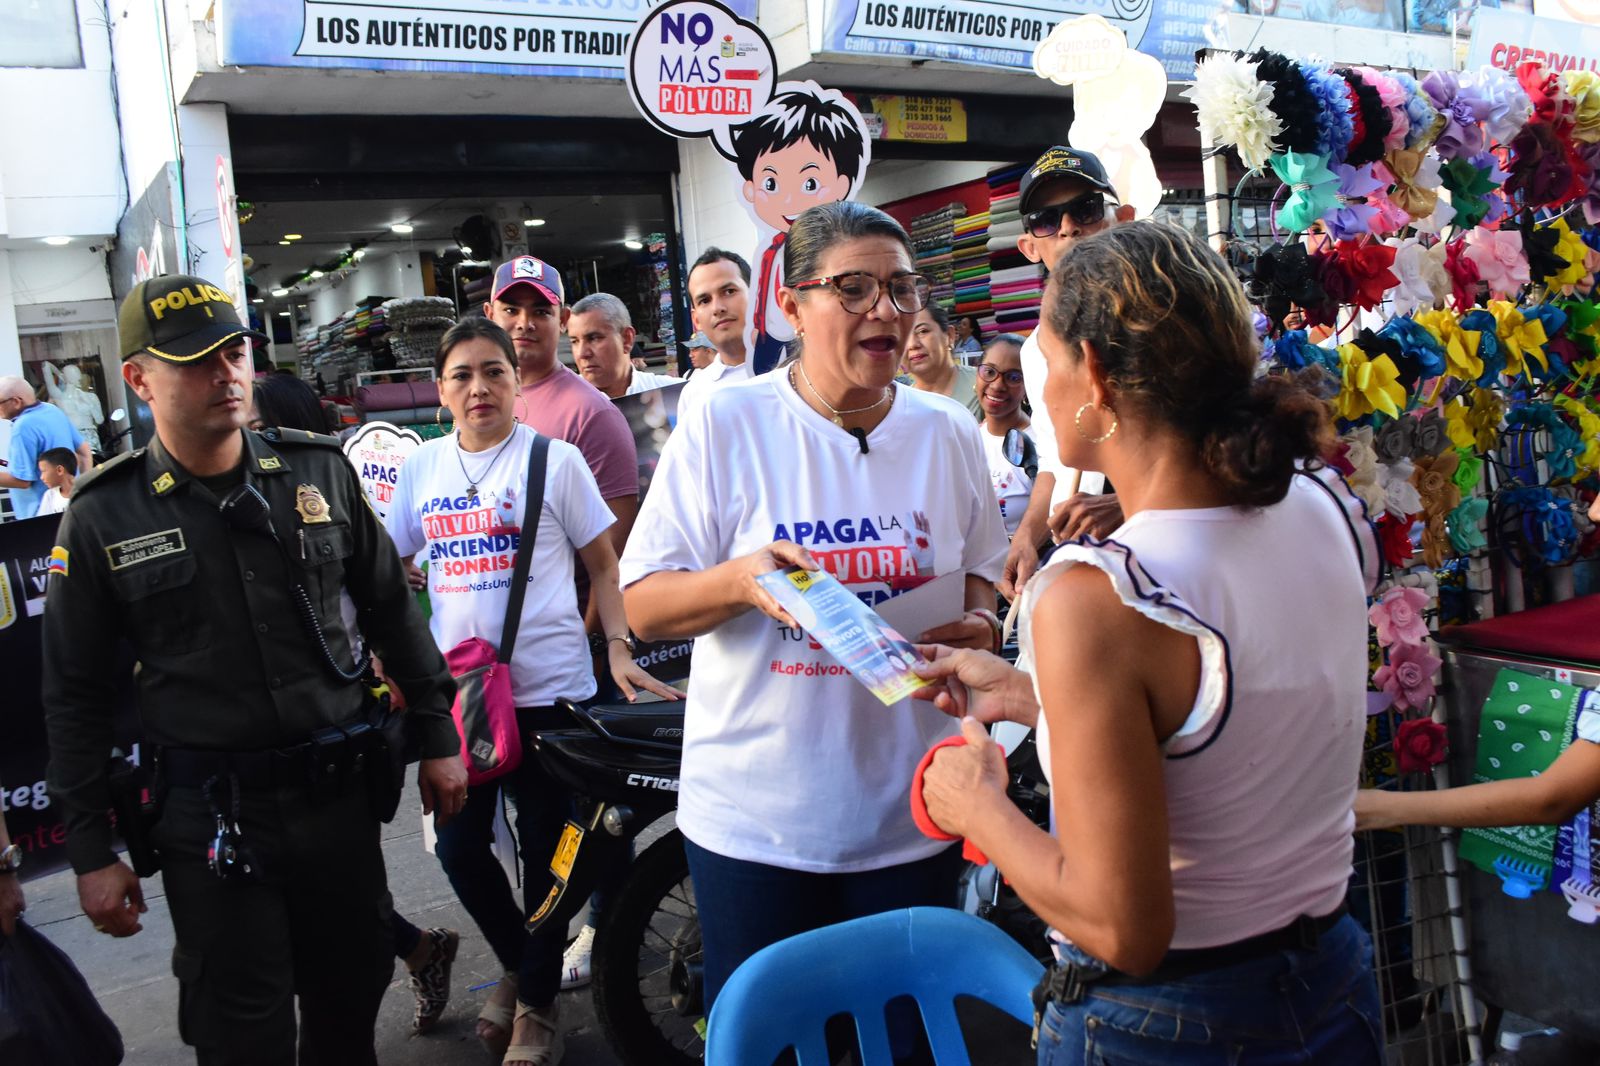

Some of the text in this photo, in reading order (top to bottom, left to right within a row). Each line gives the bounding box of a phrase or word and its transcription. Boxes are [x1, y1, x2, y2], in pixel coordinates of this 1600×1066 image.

[317, 17, 361, 44] LOS
[366, 17, 508, 50] AUTÉNTICOS
[513, 28, 556, 53] POR
[661, 12, 714, 46] NO
[865, 2, 899, 27] LOS
[901, 5, 1006, 37] AUTÉNTICOS
[1010, 17, 1042, 42] POR
[844, 37, 874, 52] Calle
[1056, 38, 1112, 53] CUIDADO
[659, 46, 721, 83] MÁS
[660, 85, 751, 114] PÓLVORA
[362, 462, 398, 485] APAG
[422, 494, 481, 516] APAGA
[422, 507, 503, 539] PÓLVORA
[772, 515, 903, 545] APAGA LA
[148, 541, 176, 556] LOPEZ
[429, 533, 521, 560] ENCIENDE
[777, 626, 804, 642] TU
